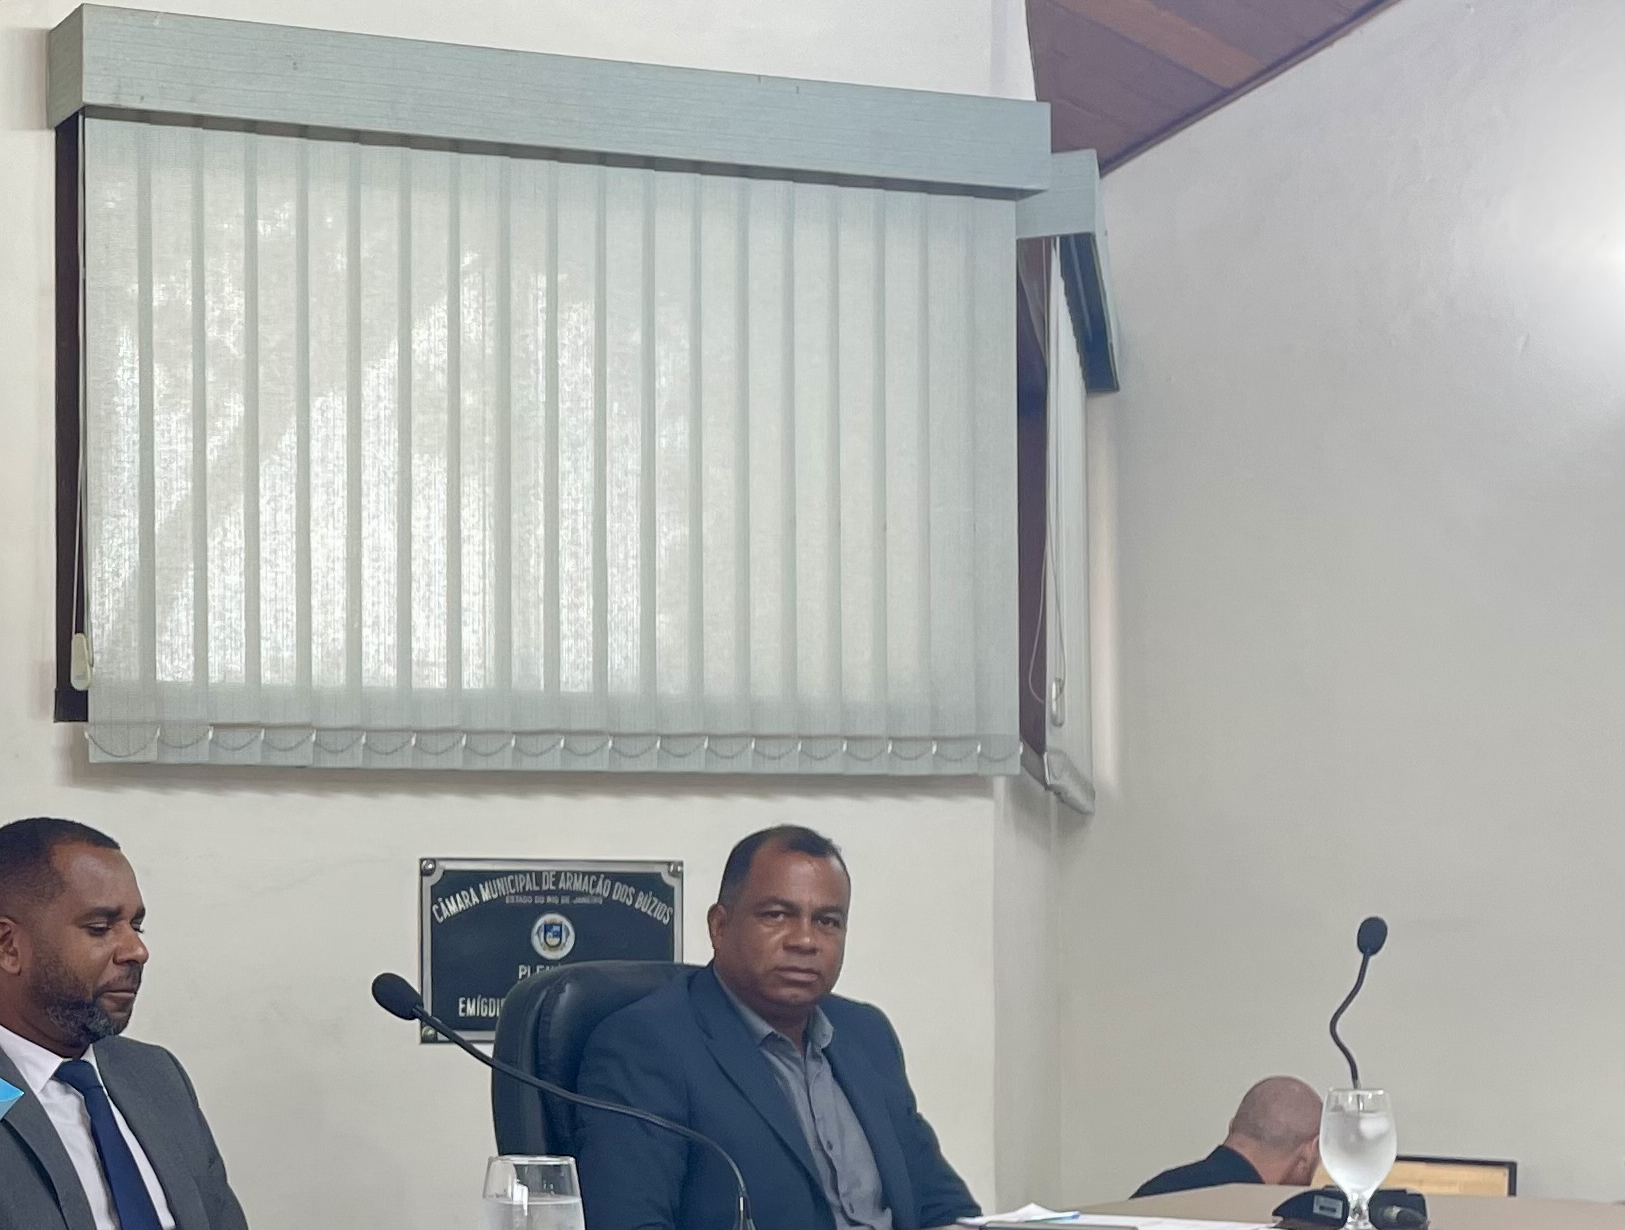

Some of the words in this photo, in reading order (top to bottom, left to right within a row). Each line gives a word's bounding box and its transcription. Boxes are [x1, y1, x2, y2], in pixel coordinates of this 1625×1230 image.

[432, 886, 479, 923] CÂMARA
[481, 872, 540, 903] MUNICIPAL
[541, 870, 556, 890] DE
[559, 871, 611, 898] ARMAÇÃO
[612, 882, 634, 904] DOS
[635, 891, 674, 925] BÚZIOS
